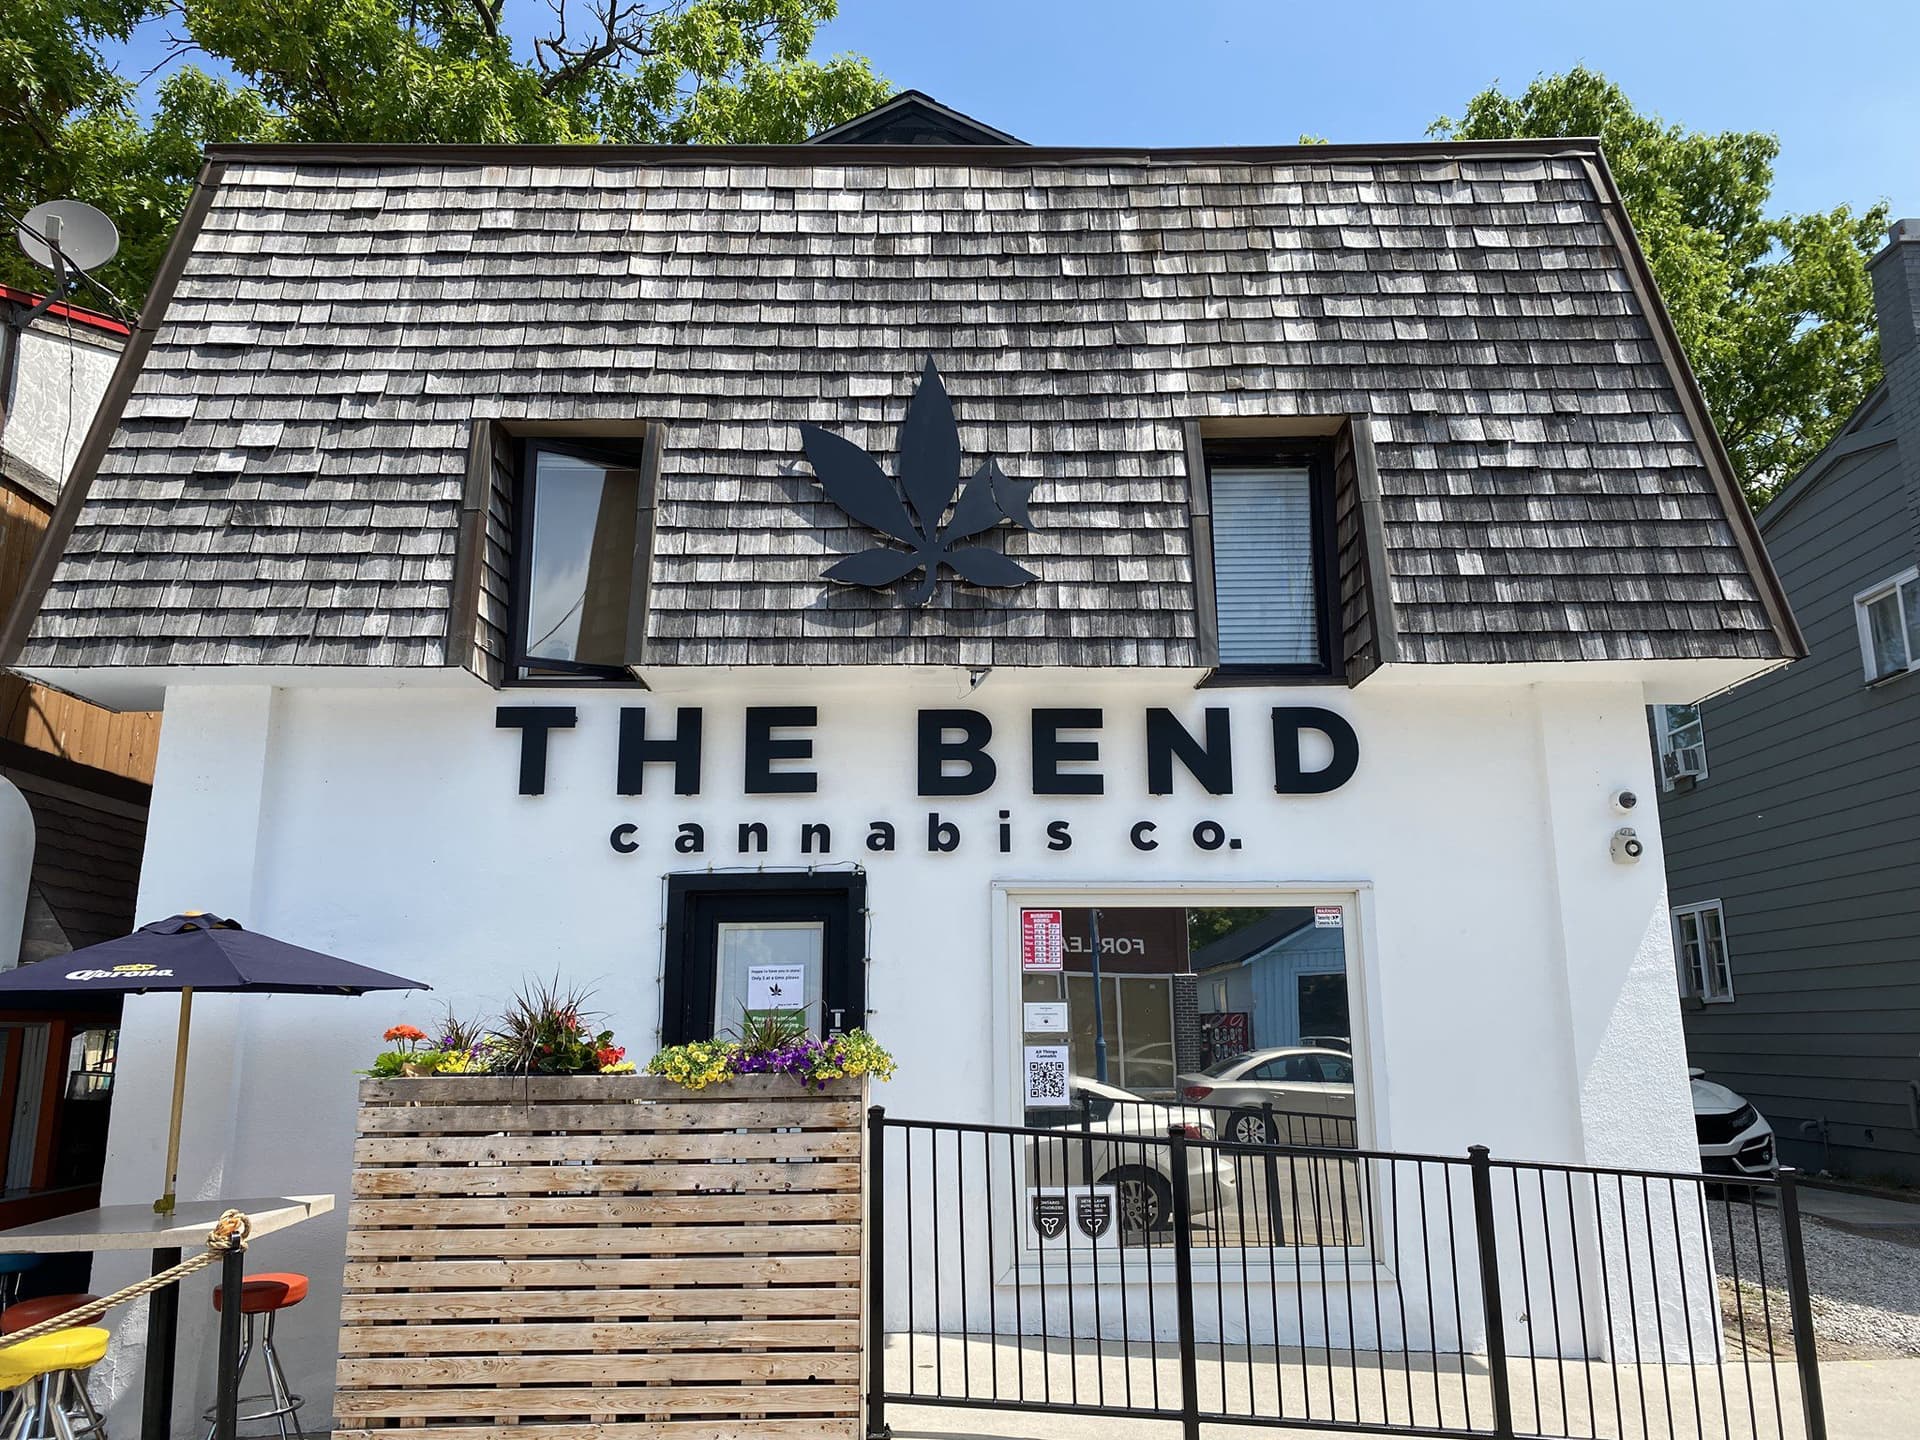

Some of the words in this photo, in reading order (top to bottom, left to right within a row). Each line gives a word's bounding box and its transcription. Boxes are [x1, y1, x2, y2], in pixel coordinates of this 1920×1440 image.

[496, 706, 817, 794] THE
[918, 706, 1359, 794] BEND
[610, 811, 1071, 853] cannabis
[1131, 820, 1241, 850] co.
[65, 969, 175, 981] Corona
